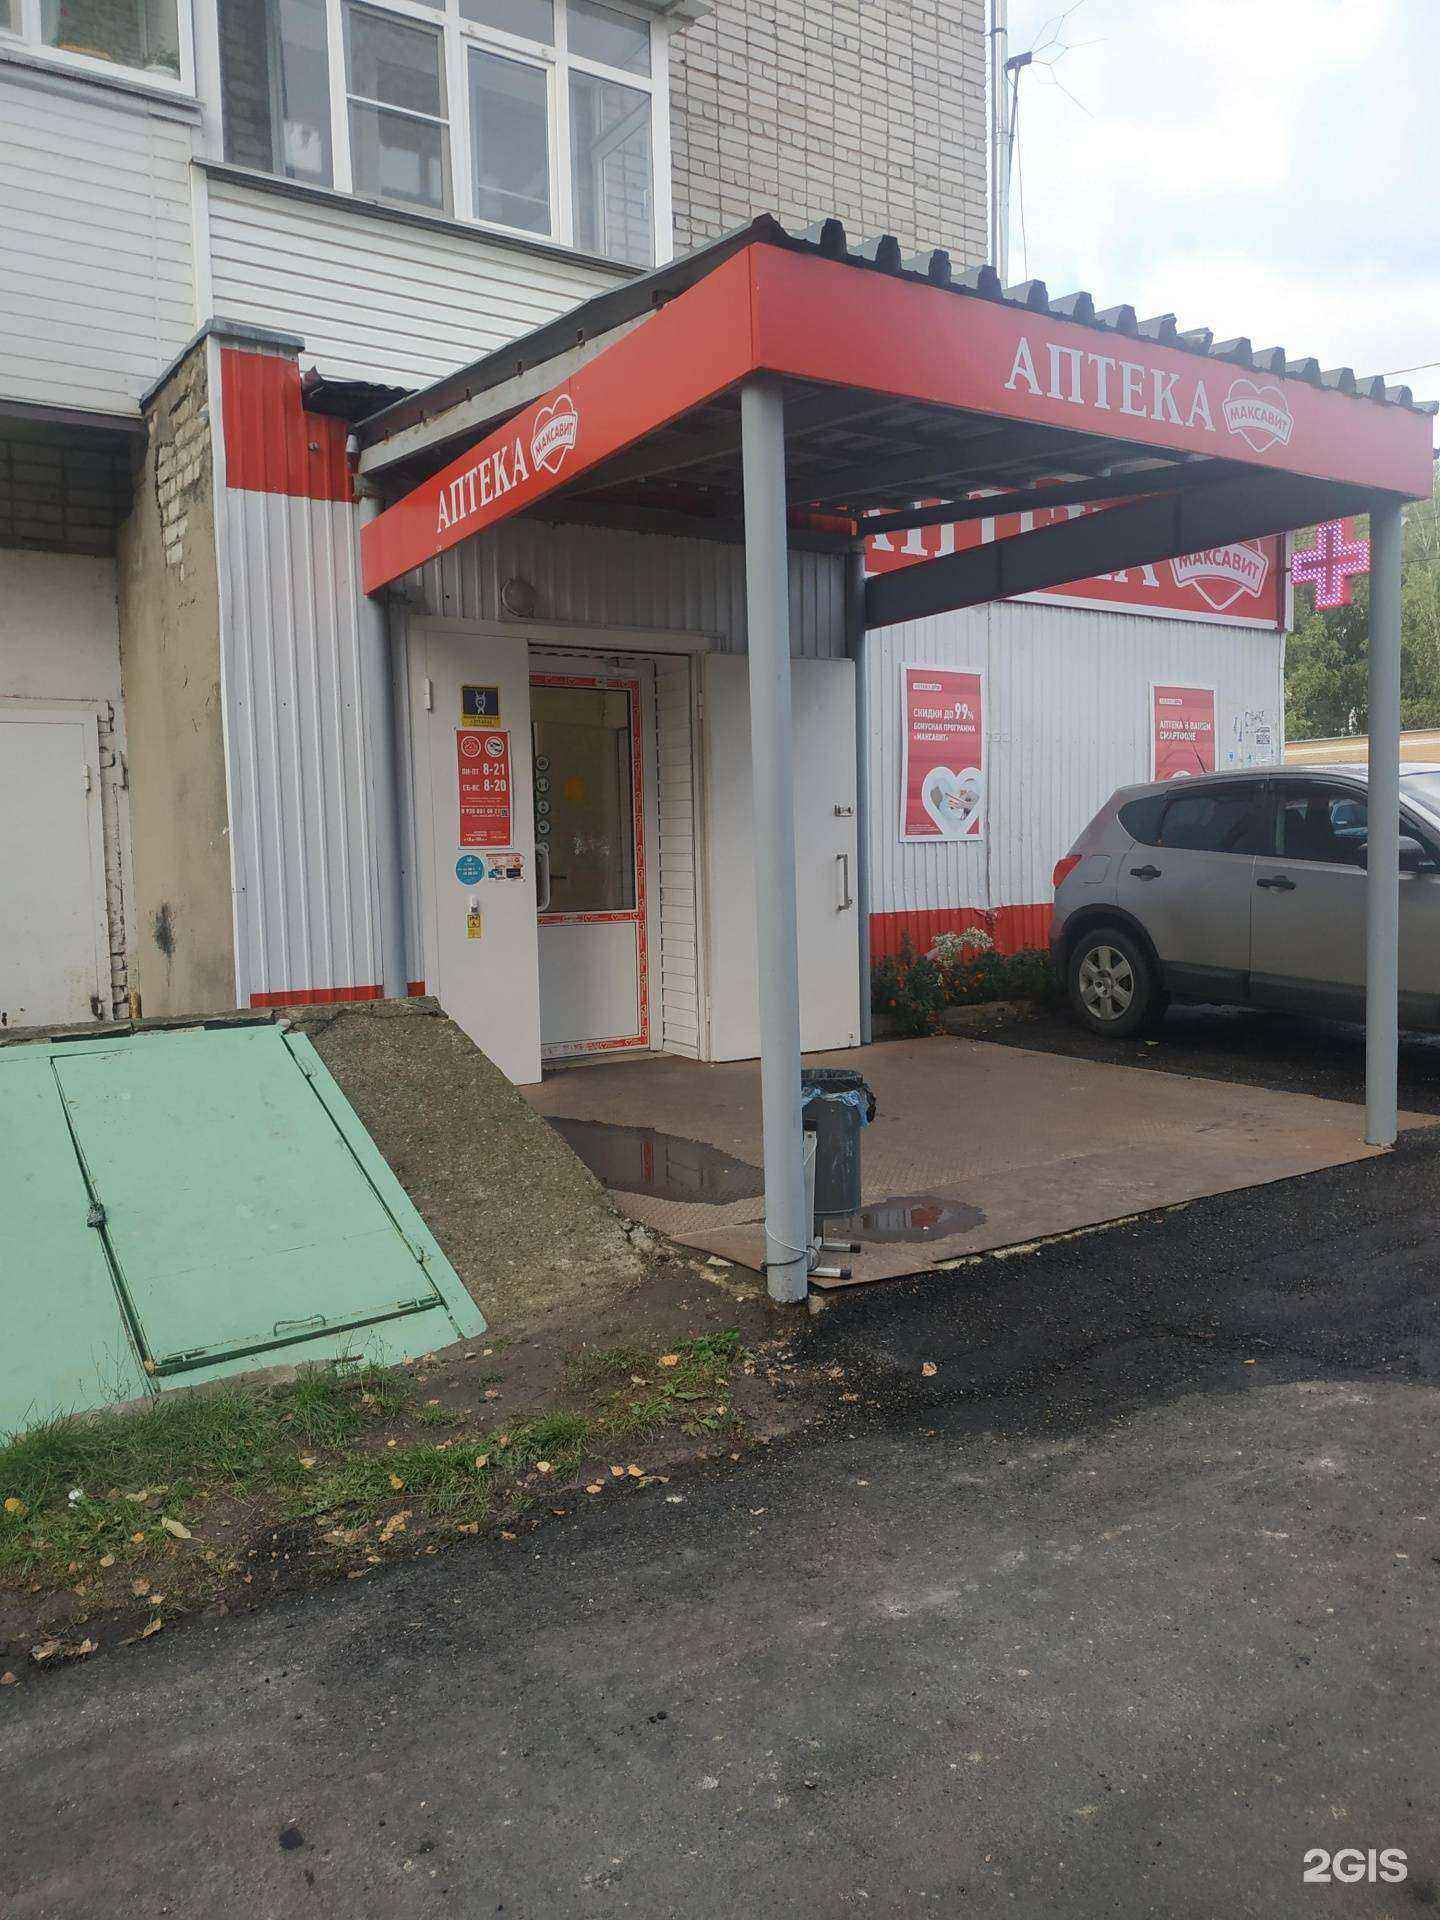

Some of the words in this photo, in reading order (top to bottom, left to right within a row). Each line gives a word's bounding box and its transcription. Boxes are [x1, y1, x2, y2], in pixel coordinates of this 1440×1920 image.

[1004, 336, 1216, 432] АПТЕКА
[1230, 405, 1288, 434] МАКСАВИТ
[536, 422, 574, 454] МАКСАВИТ
[436, 437, 530, 533] АПТЕКА
[1179, 549, 1260, 579] МАКСАВИТ
[914, 708, 942, 719] СКИДКИ
[944, 710, 953, 720] ДО
[483, 763, 505, 775] 8-21
[484, 779, 507, 792] 8-20
